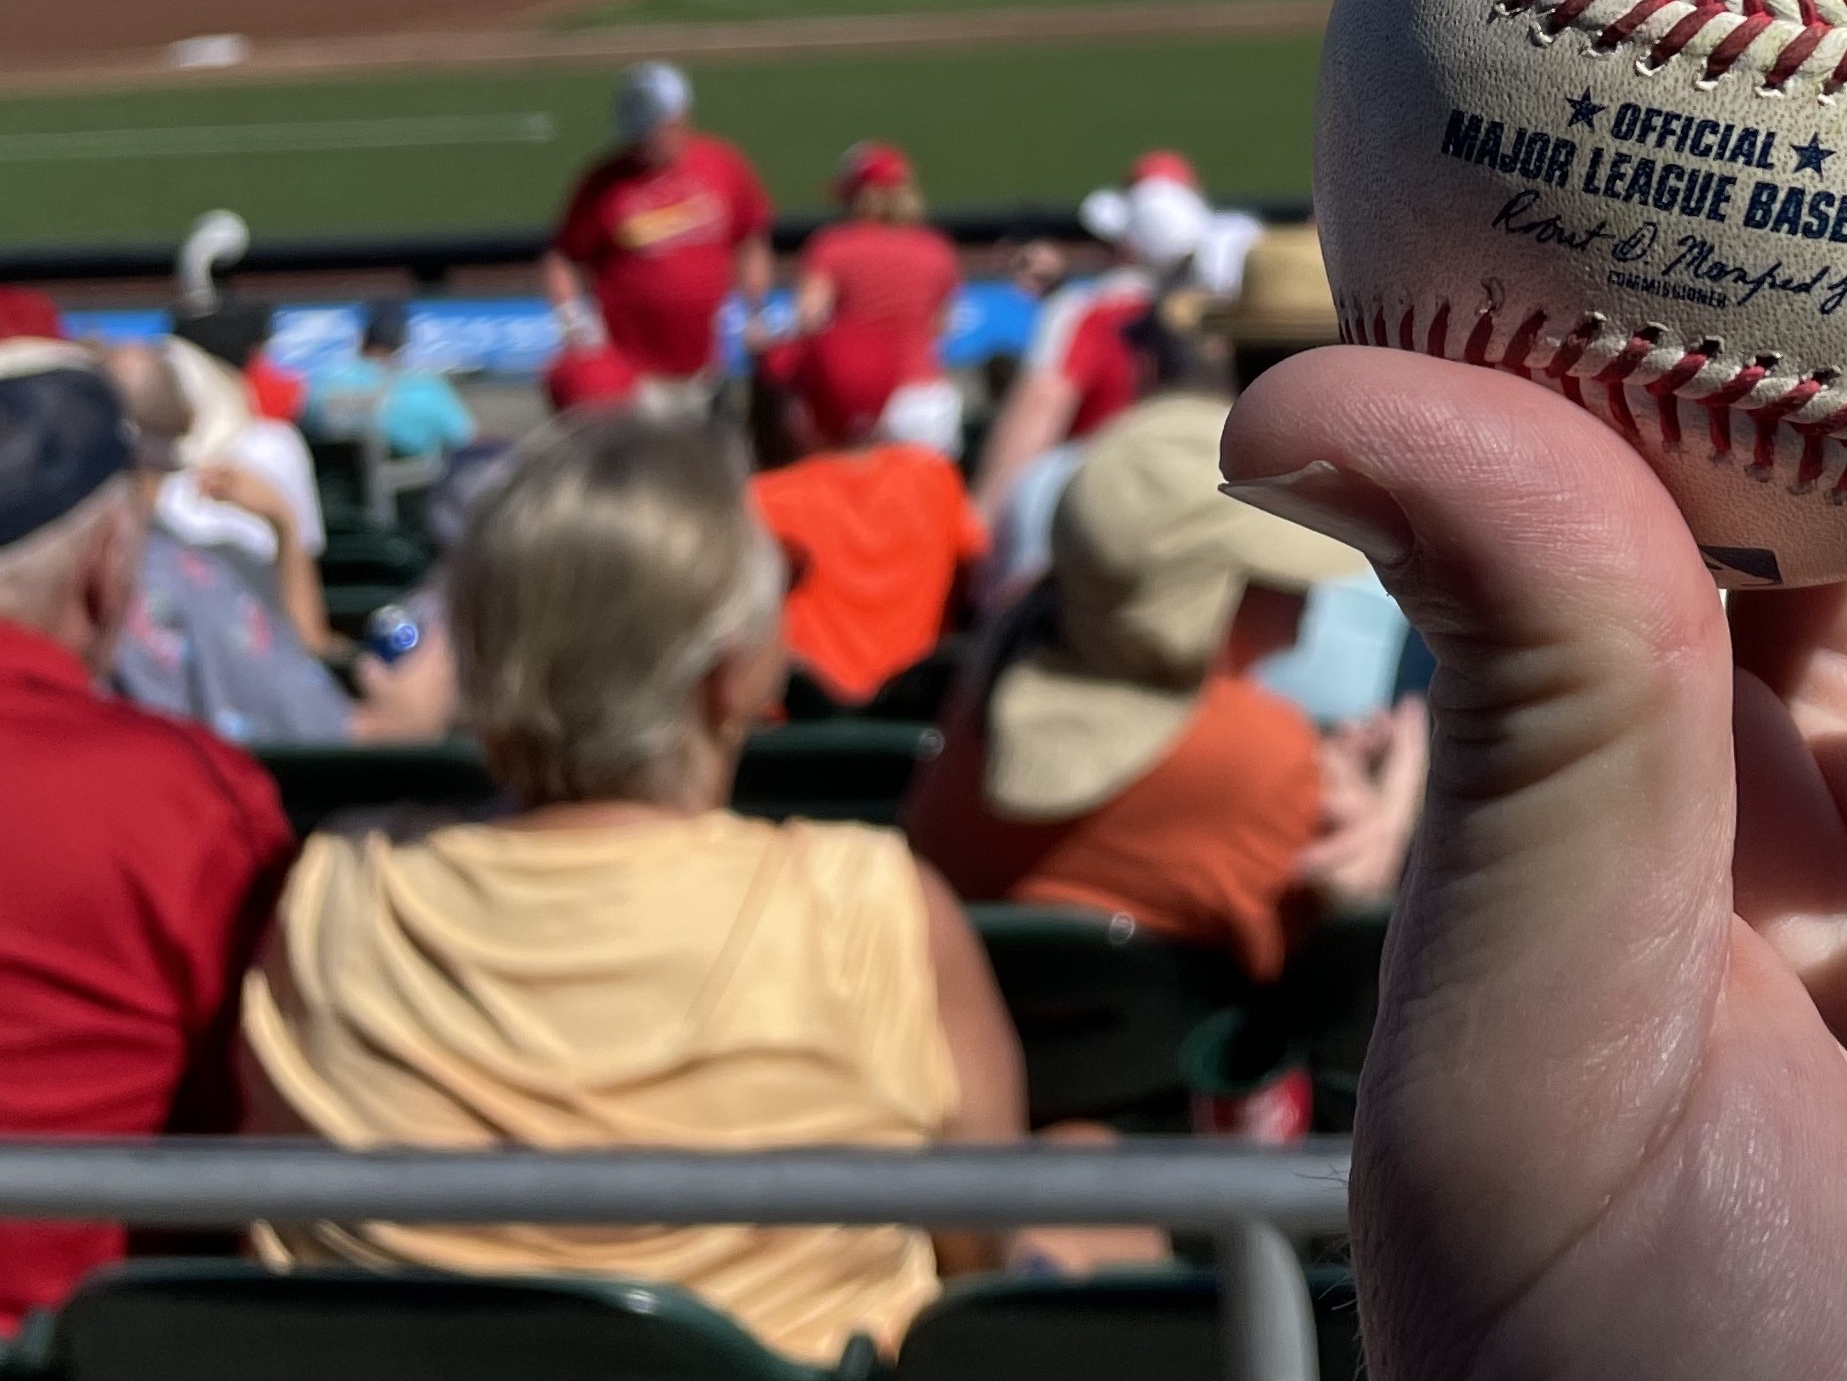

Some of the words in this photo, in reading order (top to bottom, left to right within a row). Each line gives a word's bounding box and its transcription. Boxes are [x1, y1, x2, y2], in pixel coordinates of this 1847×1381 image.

[1440, 108, 1577, 189] MAJOR
[1582, 146, 1738, 223] LEAGUE
[1611, 101, 1777, 170] OFFICIAL
